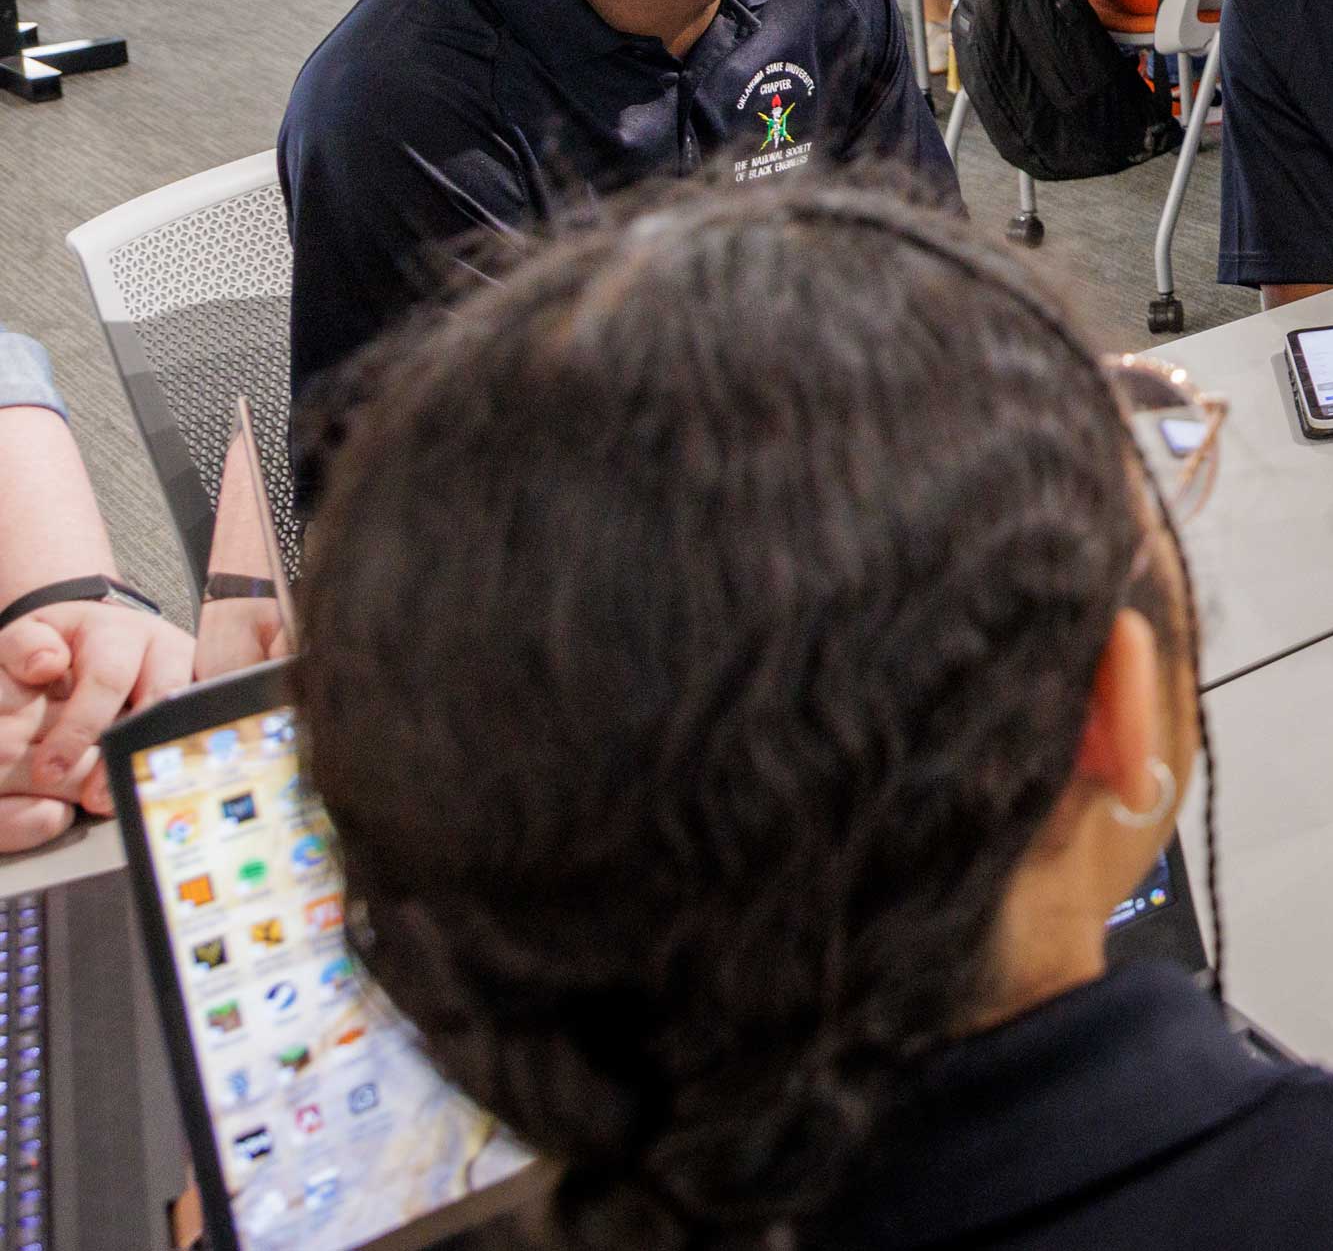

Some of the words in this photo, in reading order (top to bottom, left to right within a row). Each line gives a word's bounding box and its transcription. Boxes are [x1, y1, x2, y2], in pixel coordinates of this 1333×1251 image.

[736, 70, 766, 110] OKLAHOMA
[765, 61, 784, 75] STATE
[759, 78, 793, 95] CHAPTER
[735, 160, 748, 172] THE
[751, 149, 783, 168] NATIONAL
[785, 141, 812, 158] SOCIETY
[735, 172, 746, 182] OF
[748, 163, 773, 179] BLACK
